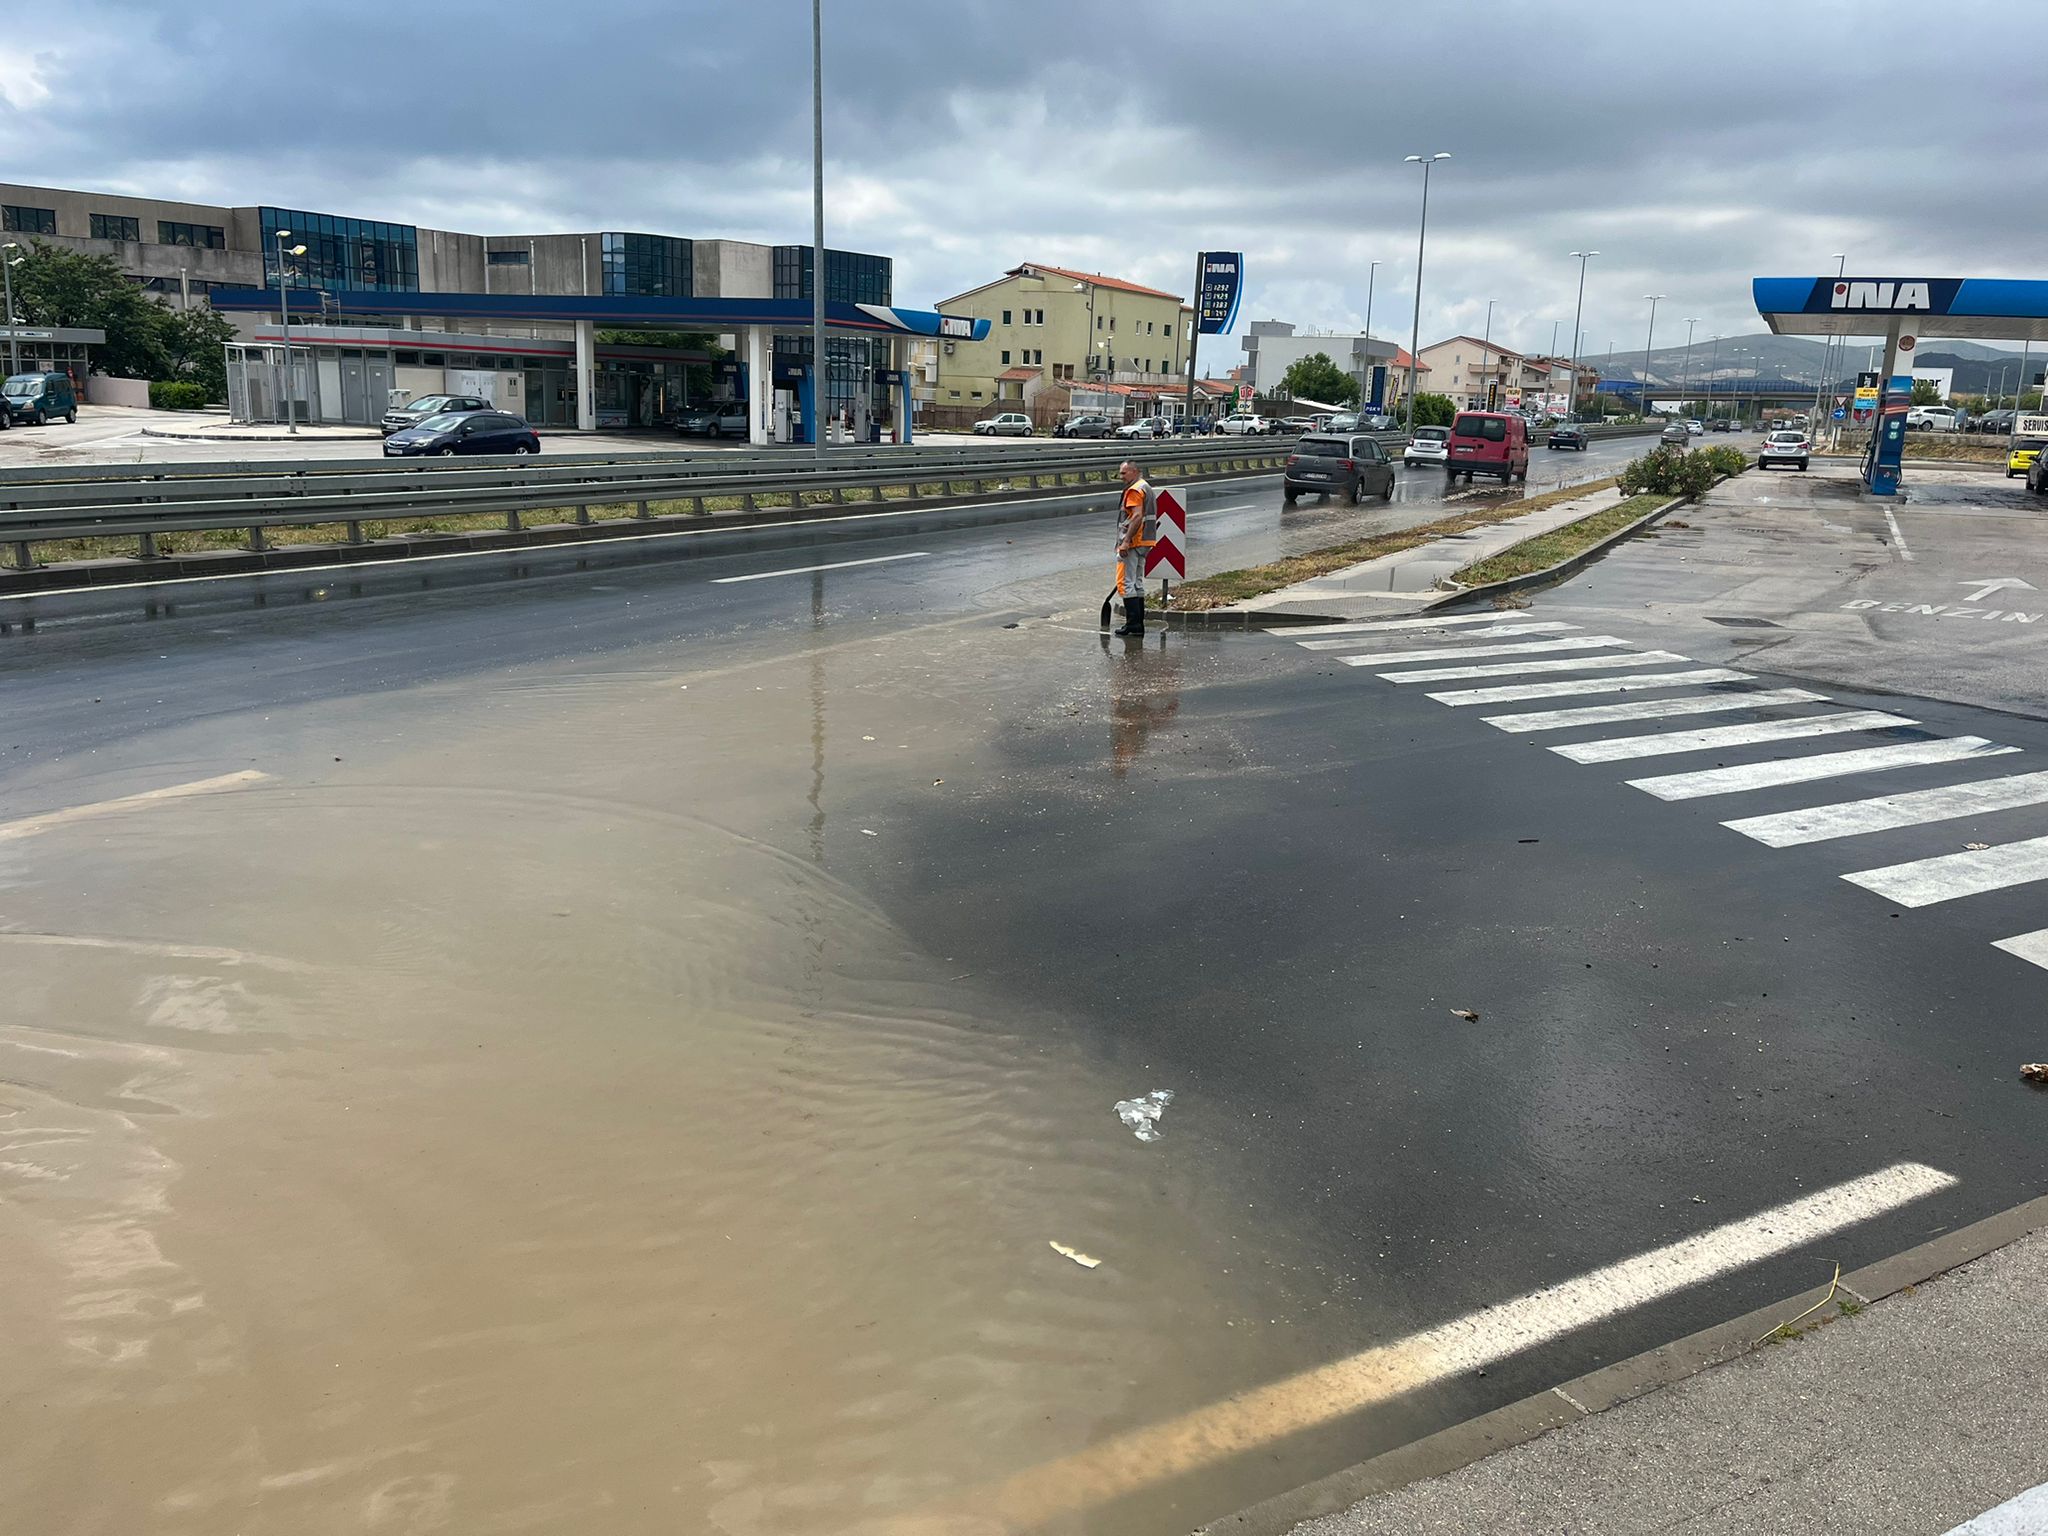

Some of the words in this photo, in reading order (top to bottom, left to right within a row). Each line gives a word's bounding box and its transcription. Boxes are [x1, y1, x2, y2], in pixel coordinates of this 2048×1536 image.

[1831, 282, 1930, 309] INA
[943, 319, 971, 337] INA
[1839, 599, 2044, 624] BENZIN
